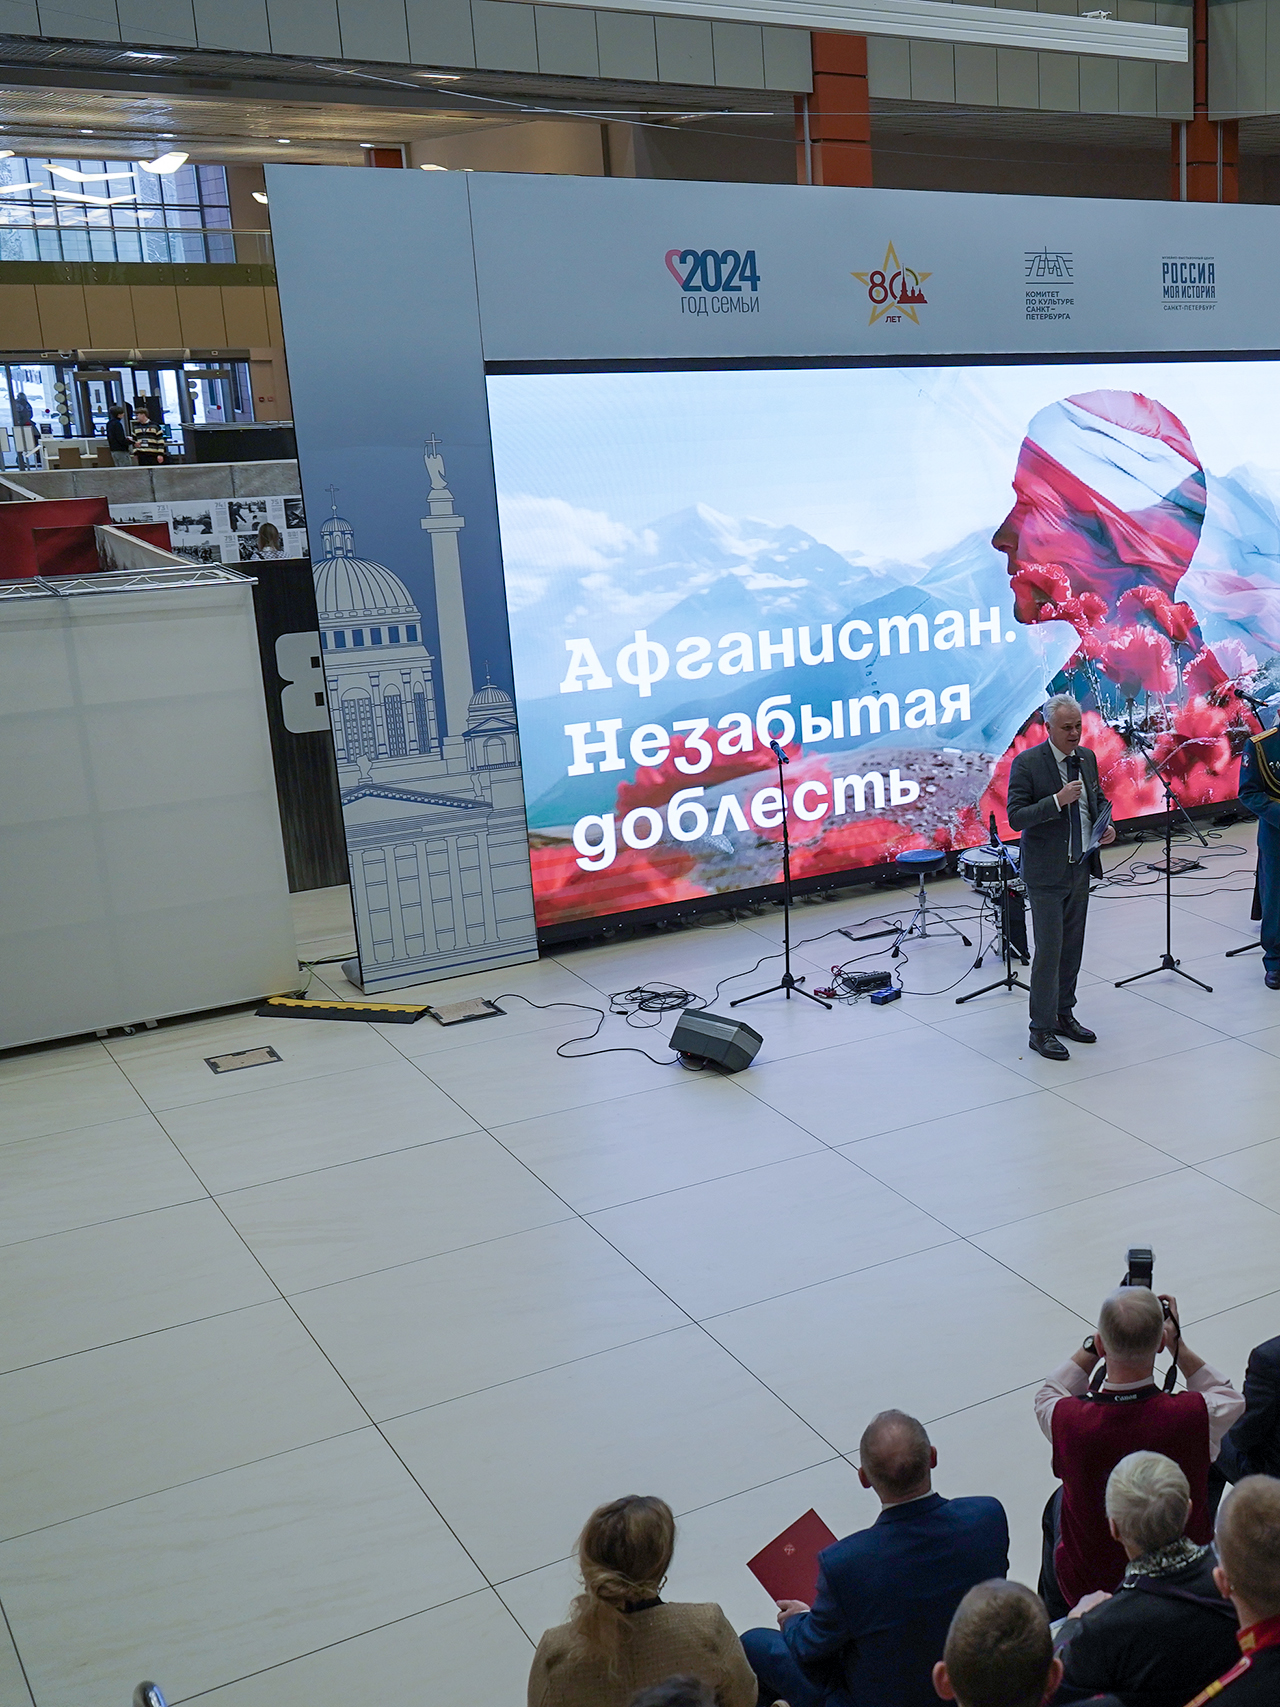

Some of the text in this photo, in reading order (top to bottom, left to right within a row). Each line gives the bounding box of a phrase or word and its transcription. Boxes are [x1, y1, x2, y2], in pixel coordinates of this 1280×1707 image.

[679, 249, 761, 293] 2024
[1162, 262, 1215, 284] РОССИЯ
[1025, 290, 1060, 298] КОМИТЕТ
[1163, 285, 1216, 299] МОЯ ИСТОРИЯ
[885, 315, 902, 323] ЛЕТ
[559, 604, 1017, 697] Афганистан.
[563, 682, 971, 777] Незабытая
[572, 766, 922, 873] доблесть
[1114, 1394, 1138, 1402] Canon
